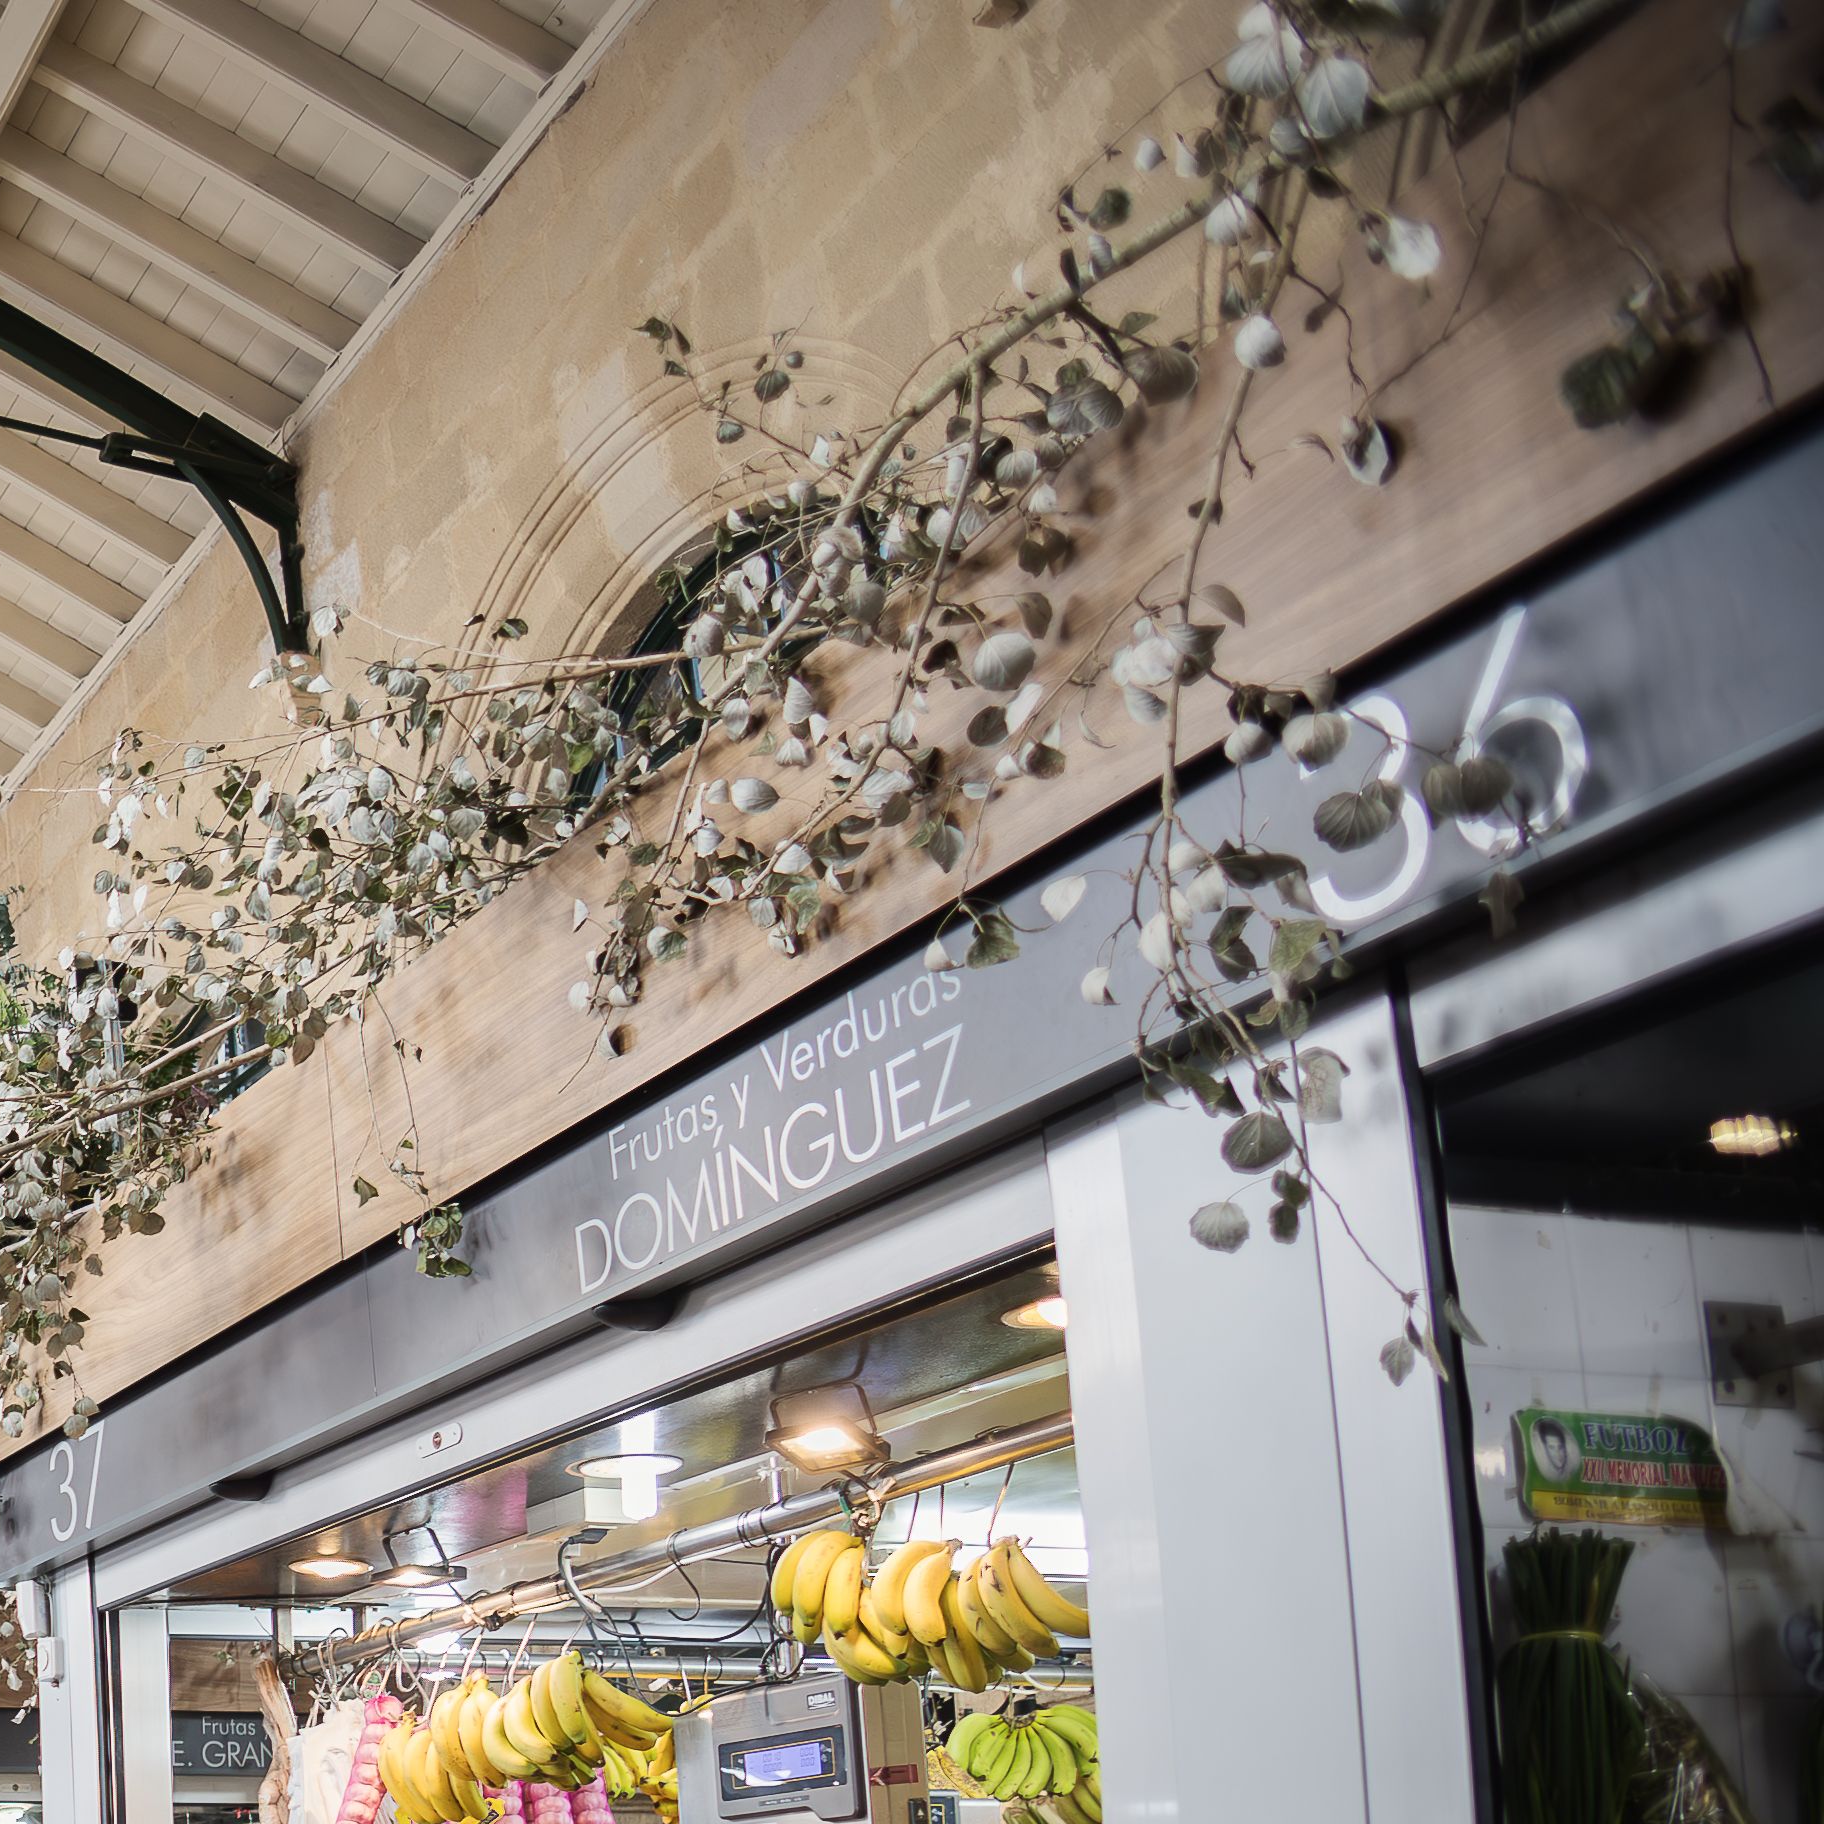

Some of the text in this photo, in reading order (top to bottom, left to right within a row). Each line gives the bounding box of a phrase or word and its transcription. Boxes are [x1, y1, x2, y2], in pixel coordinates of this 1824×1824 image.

[1298, 605, 1589, 923] 36
[607, 969, 962, 1181] Frutas y Verduras
[574, 1022, 972, 1295] DOMÍNGUEZ
[47, 1421, 105, 1543] 37
[1581, 1421, 1694, 1456] FUTBOL
[1606, 1457, 1668, 1487] MEMORIAL
[202, 1715, 256, 1737] Frutas
